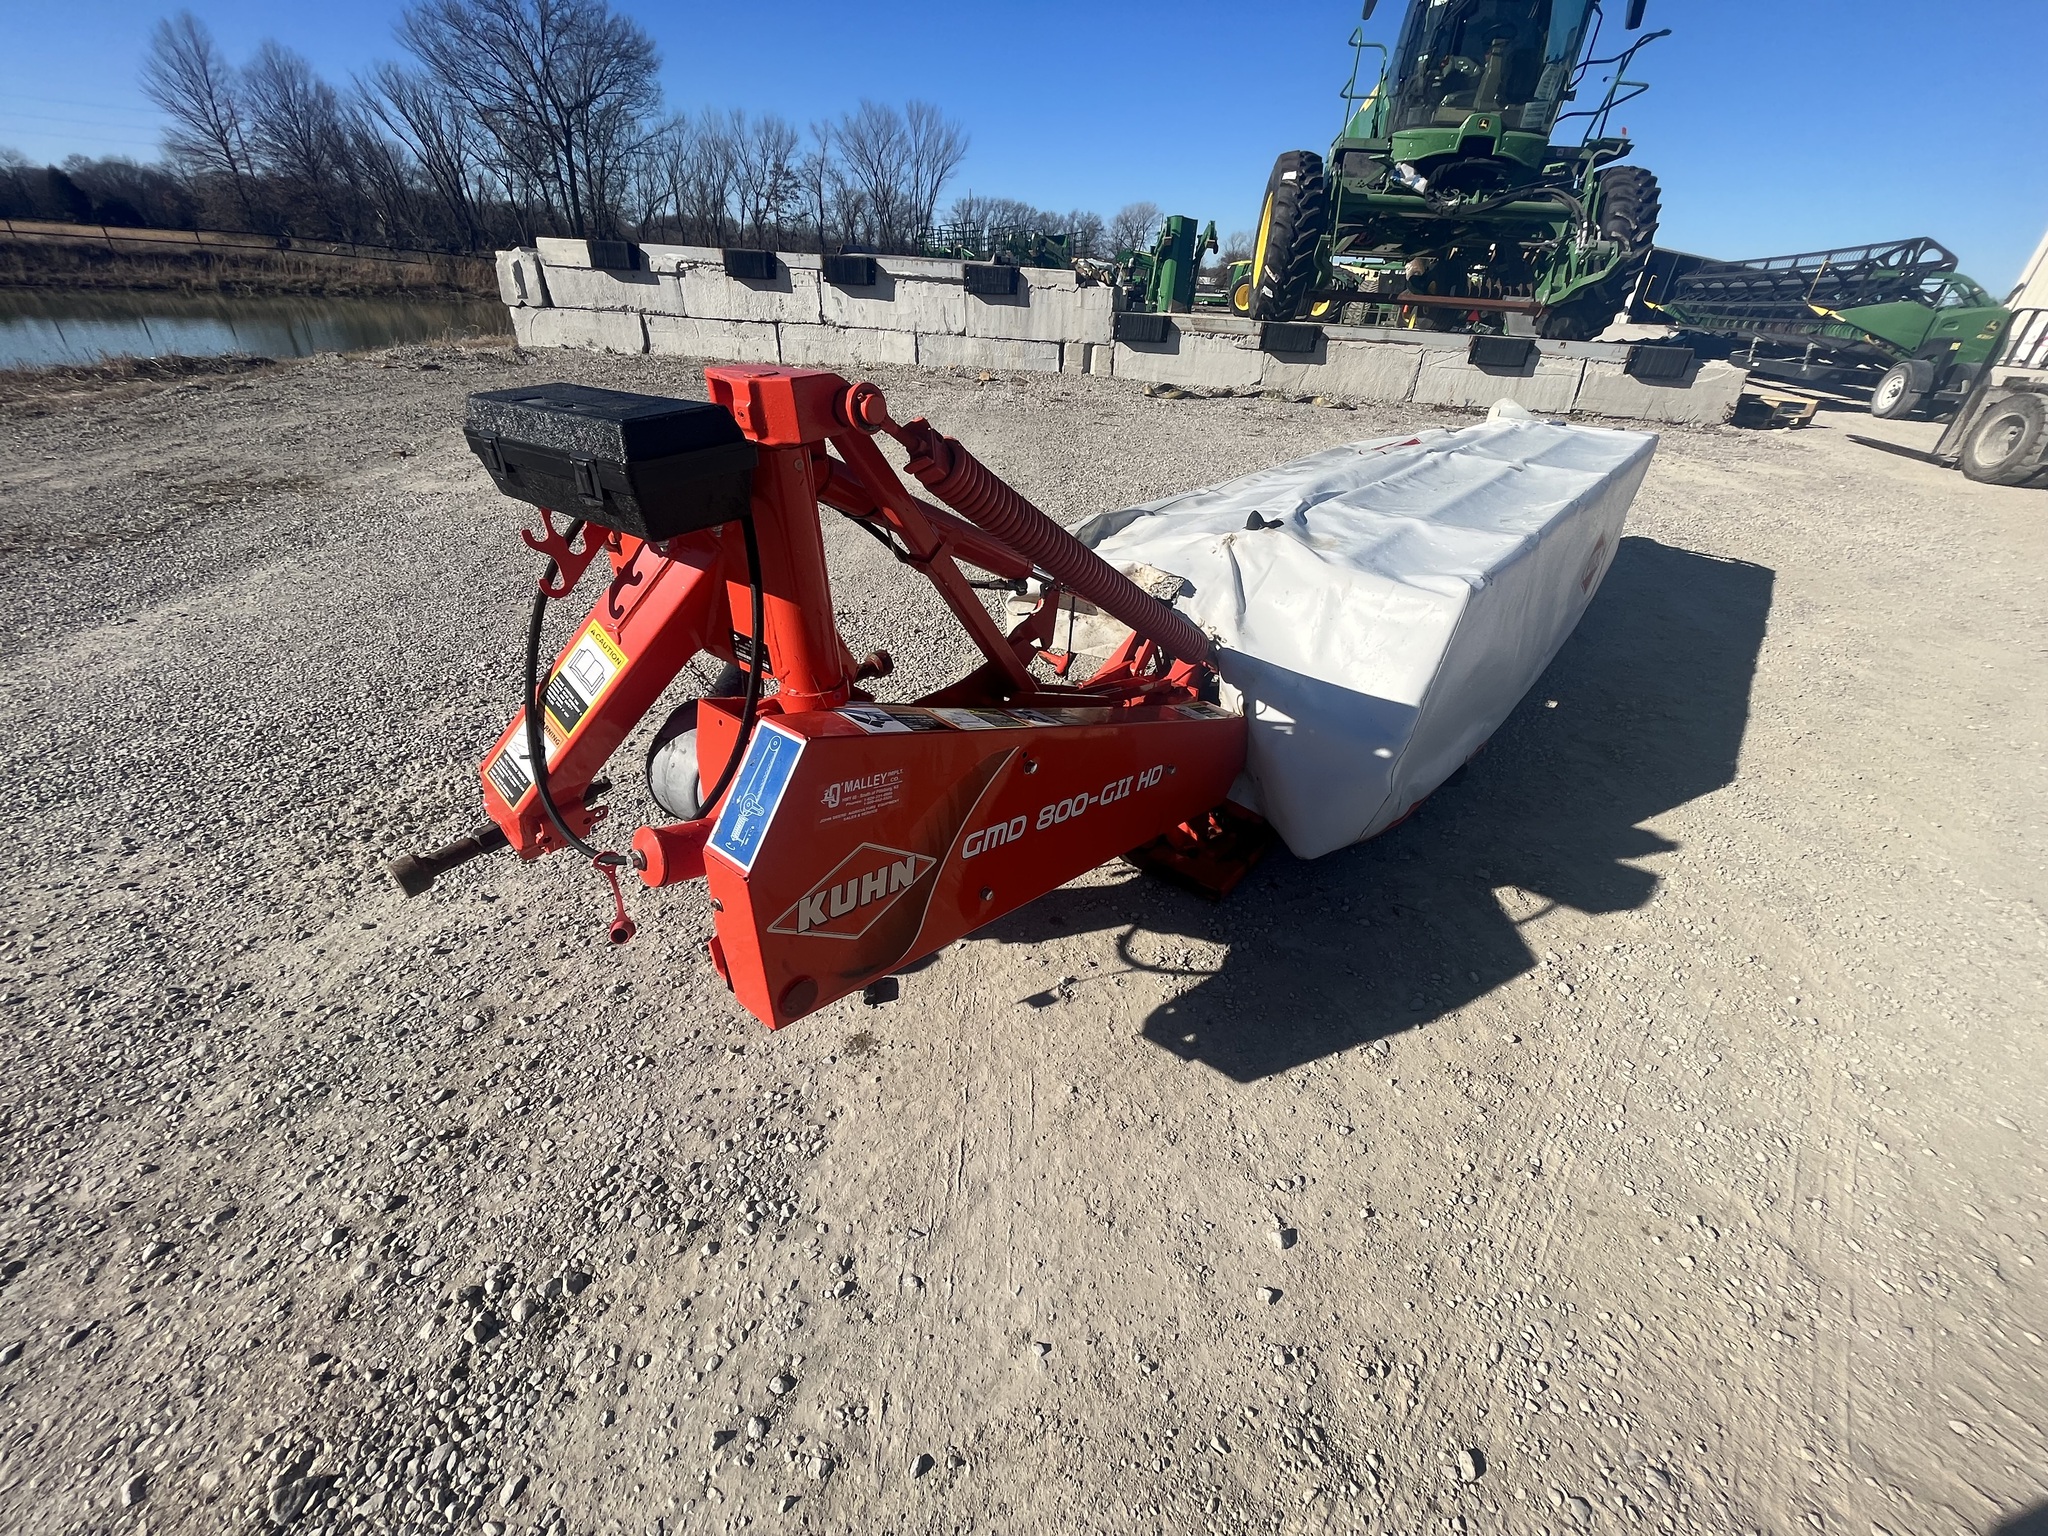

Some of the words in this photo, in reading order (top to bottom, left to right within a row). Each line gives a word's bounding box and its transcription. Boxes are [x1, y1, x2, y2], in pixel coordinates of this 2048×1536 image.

[595, 633, 622, 665] CAUTION
[824, 772, 887, 808] O'MALLEY
[962, 815, 1027, 859] GMD
[1036, 775, 1134, 831] 800-GII
[1136, 764, 1164, 792] HD
[798, 855, 916, 933] KUHN
